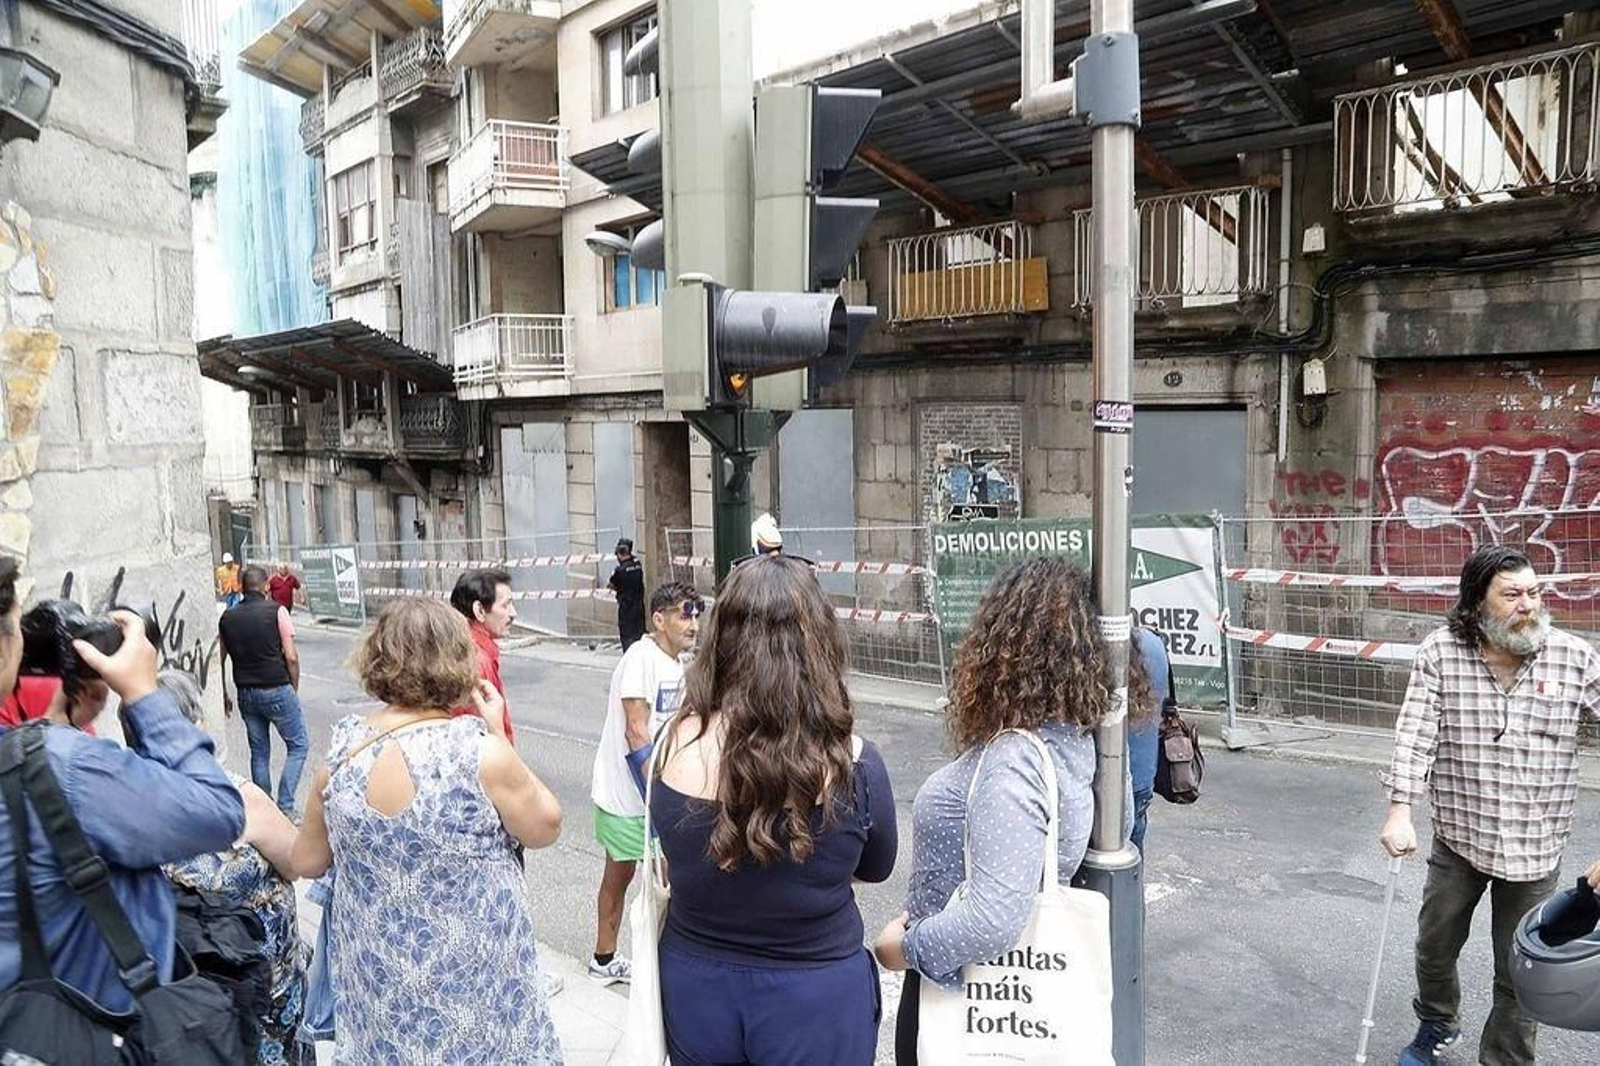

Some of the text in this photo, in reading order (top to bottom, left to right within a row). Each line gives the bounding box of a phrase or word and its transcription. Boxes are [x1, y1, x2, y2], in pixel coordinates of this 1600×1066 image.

[935, 531, 1083, 553] DEMOLICIONES
[1209, 679, 1226, 690] Vigo
[976, 946, 1067, 971] ntas
[966, 975, 1033, 1004] máis
[966, 1006, 1058, 1040] fortes.
